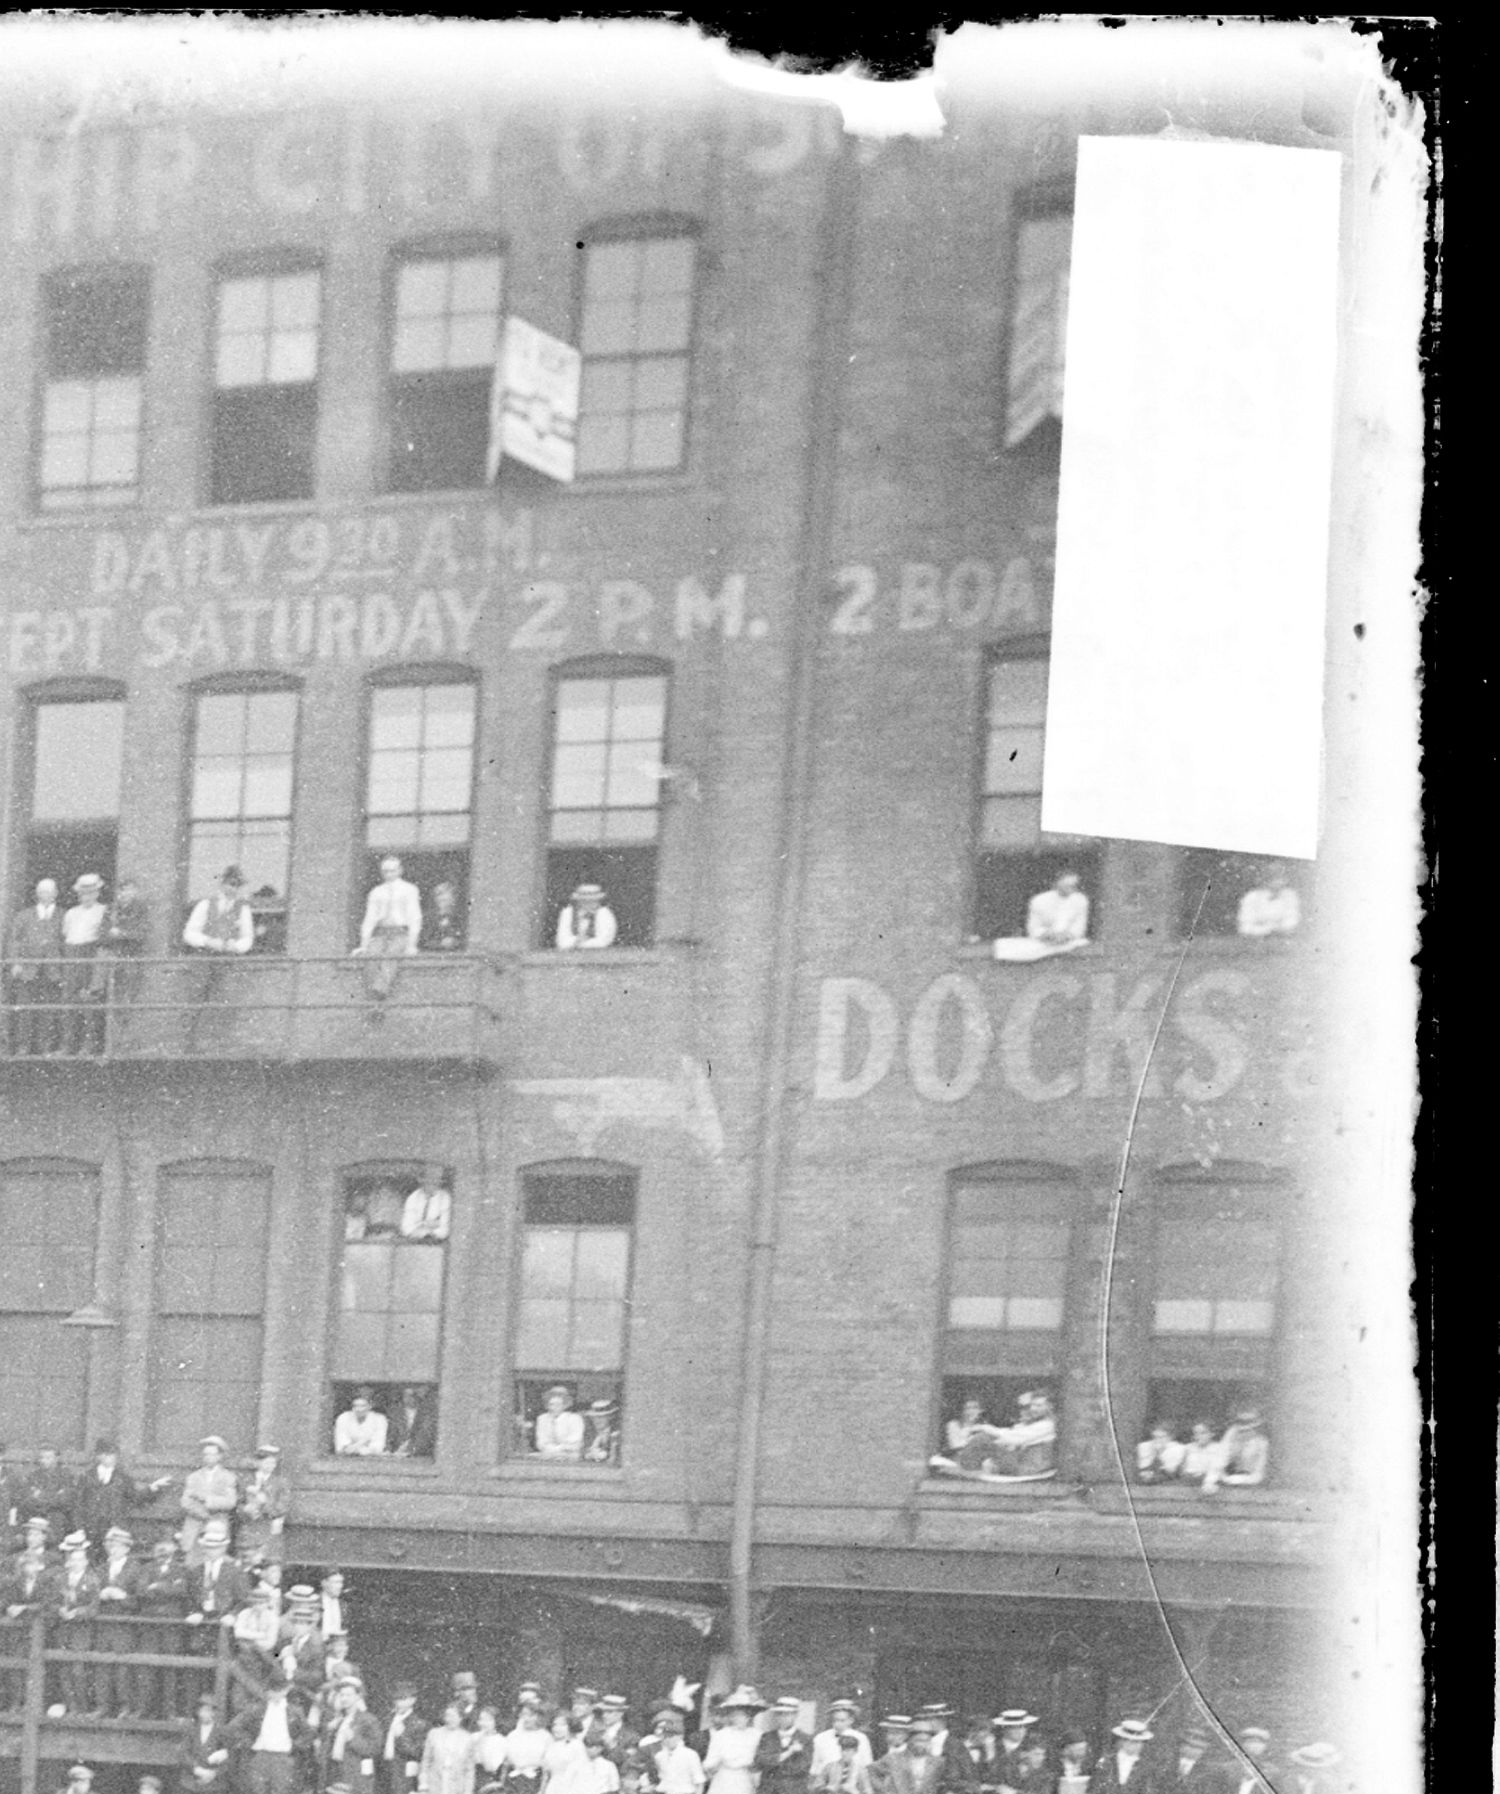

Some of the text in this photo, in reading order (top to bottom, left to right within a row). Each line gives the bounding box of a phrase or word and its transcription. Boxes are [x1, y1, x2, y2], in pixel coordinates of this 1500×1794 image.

[93, 522, 275, 594] DAILY
[830, 556, 1048, 634] 2 BOA
[141, 587, 488, 668] SATURDAY
[507, 580, 569, 650] 2
[814, 967, 1252, 1102] DOCKS
